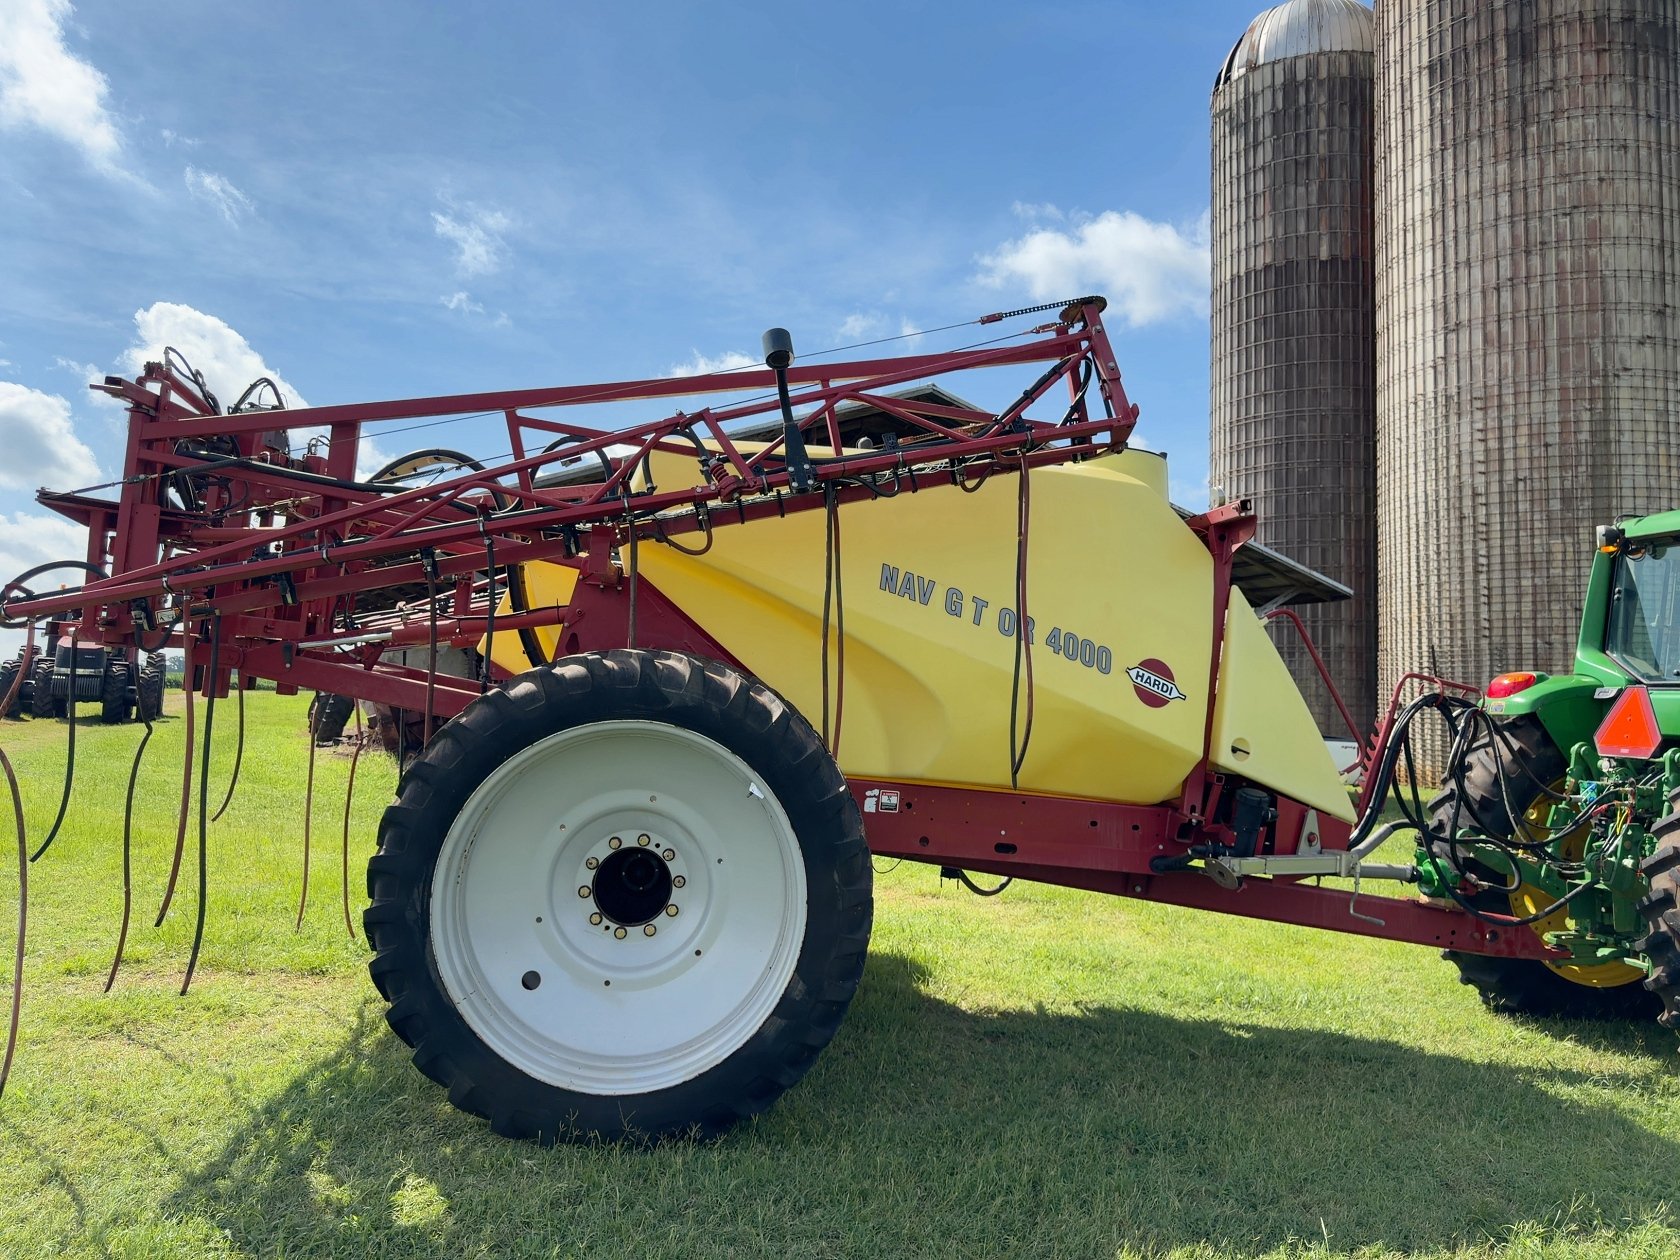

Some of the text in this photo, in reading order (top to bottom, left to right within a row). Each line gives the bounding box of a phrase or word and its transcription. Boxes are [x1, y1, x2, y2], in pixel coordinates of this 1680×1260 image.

[879, 562, 936, 606] NAV
[1045, 626, 1112, 675] 4000
[1134, 669, 1174, 697] HARDI
